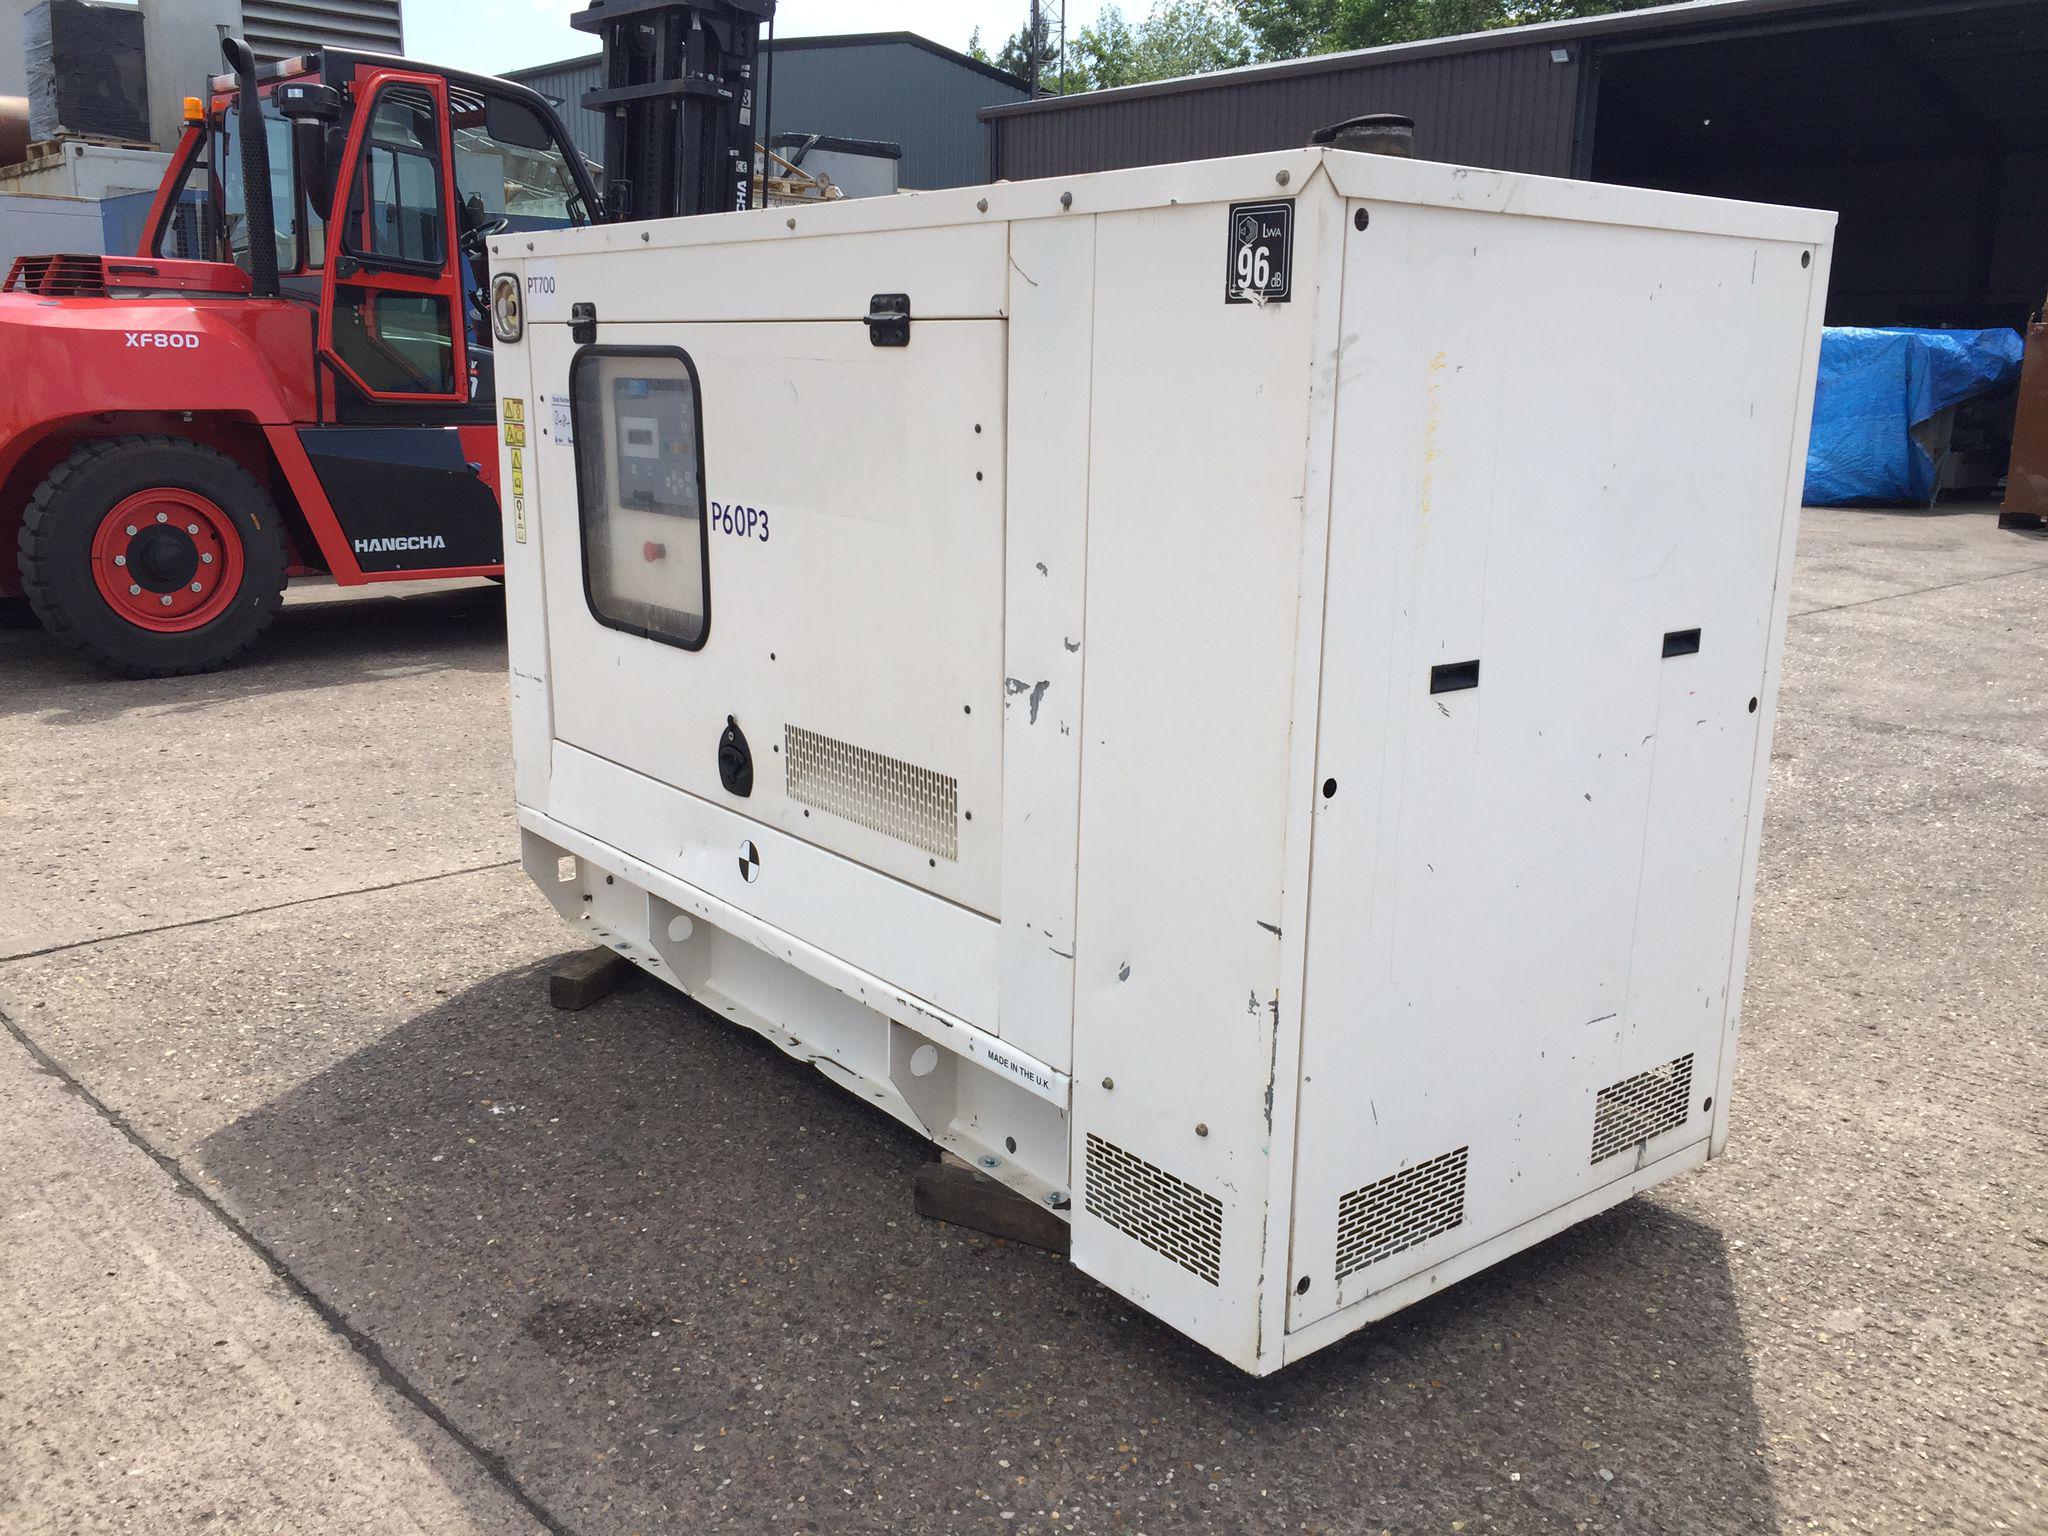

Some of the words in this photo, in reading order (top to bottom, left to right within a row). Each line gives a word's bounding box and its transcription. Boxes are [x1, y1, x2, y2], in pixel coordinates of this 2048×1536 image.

[1237, 245, 1270, 289] 96
[528, 276, 556, 294] PT700
[1270, 272, 1282, 288] dB
[124, 332, 200, 349] XF80D
[711, 501, 770, 542] P60P3
[354, 535, 446, 553] HANGCHA
[987, 1050, 1009, 1068] MADE
[1010, 1061, 1018, 1073] IN
[1019, 1066, 1035, 1082] THE
